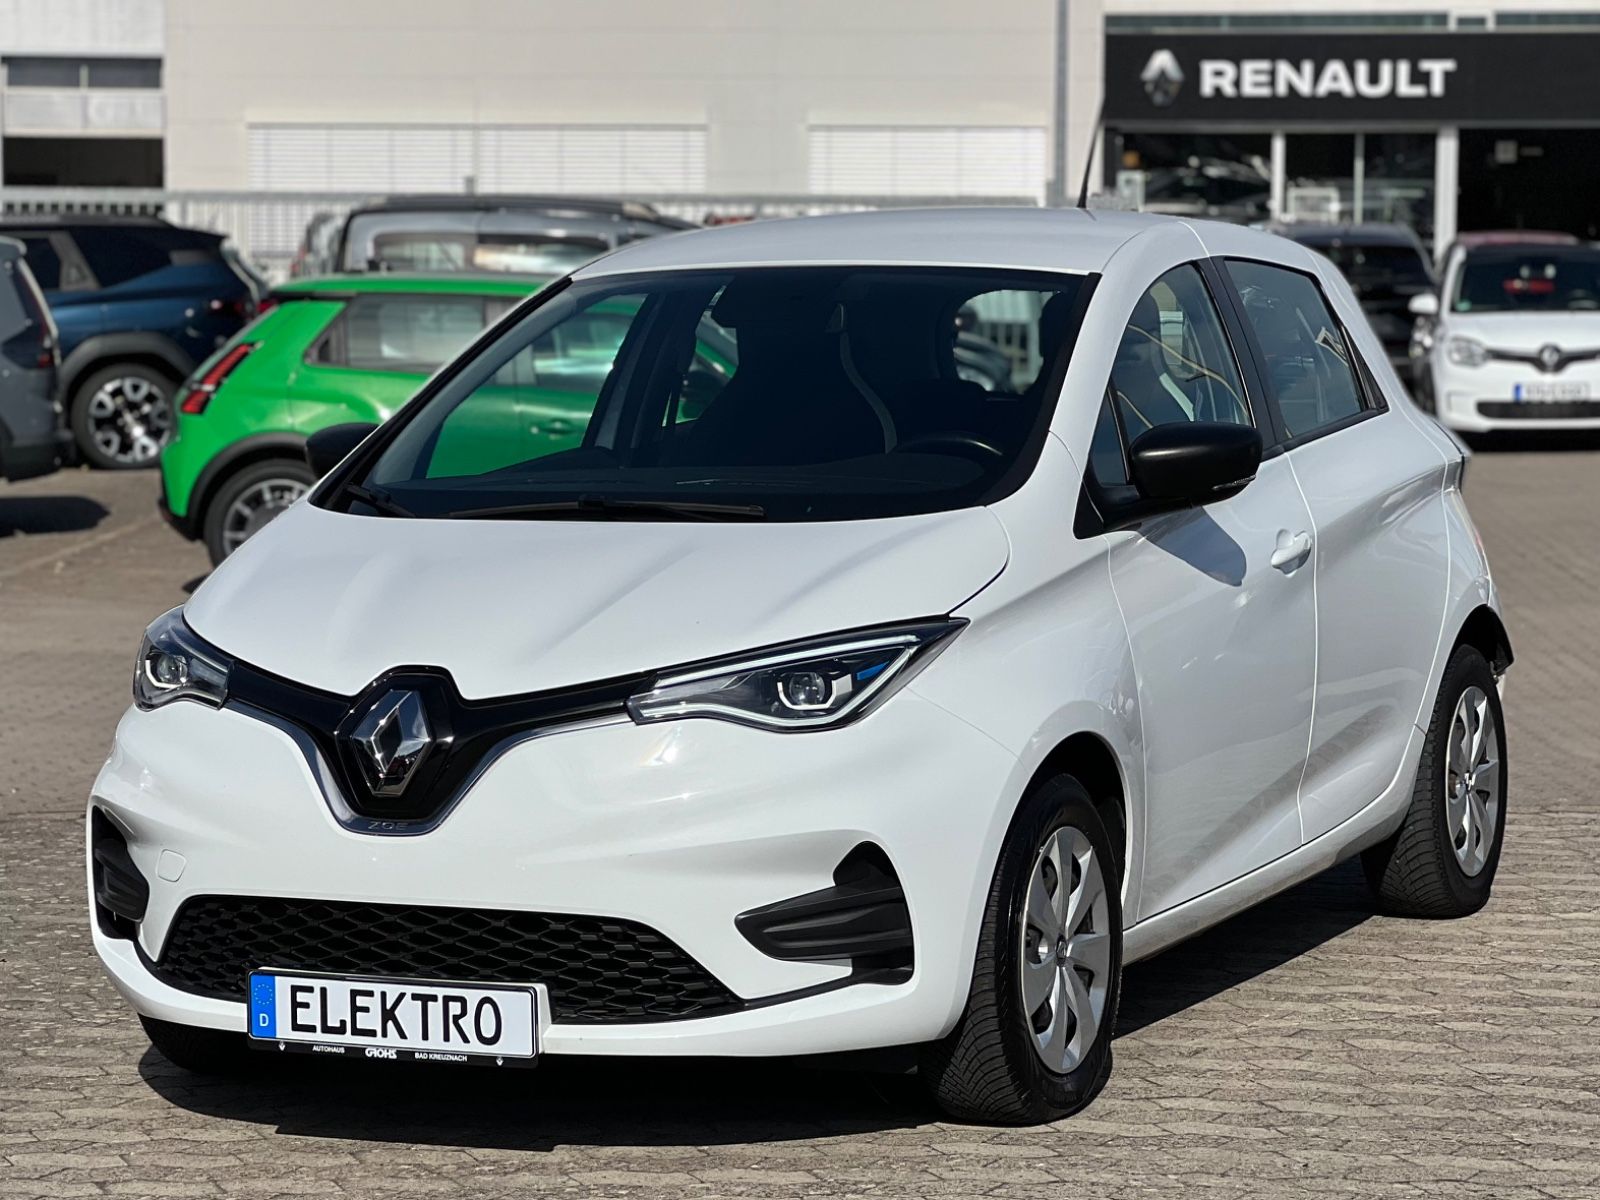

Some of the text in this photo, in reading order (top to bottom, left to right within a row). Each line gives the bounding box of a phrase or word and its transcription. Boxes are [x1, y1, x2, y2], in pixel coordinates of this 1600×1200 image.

[1200, 59, 1457, 98] RENAULT
[367, 821, 409, 831] ZOE
[258, 1013, 270, 1027] D
[289, 984, 503, 1046] ELEKTRO
[312, 1045, 345, 1054] AUTOHAUS
[414, 1052, 428, 1060] BAD
[429, 1053, 468, 1062] KREUZNACH
